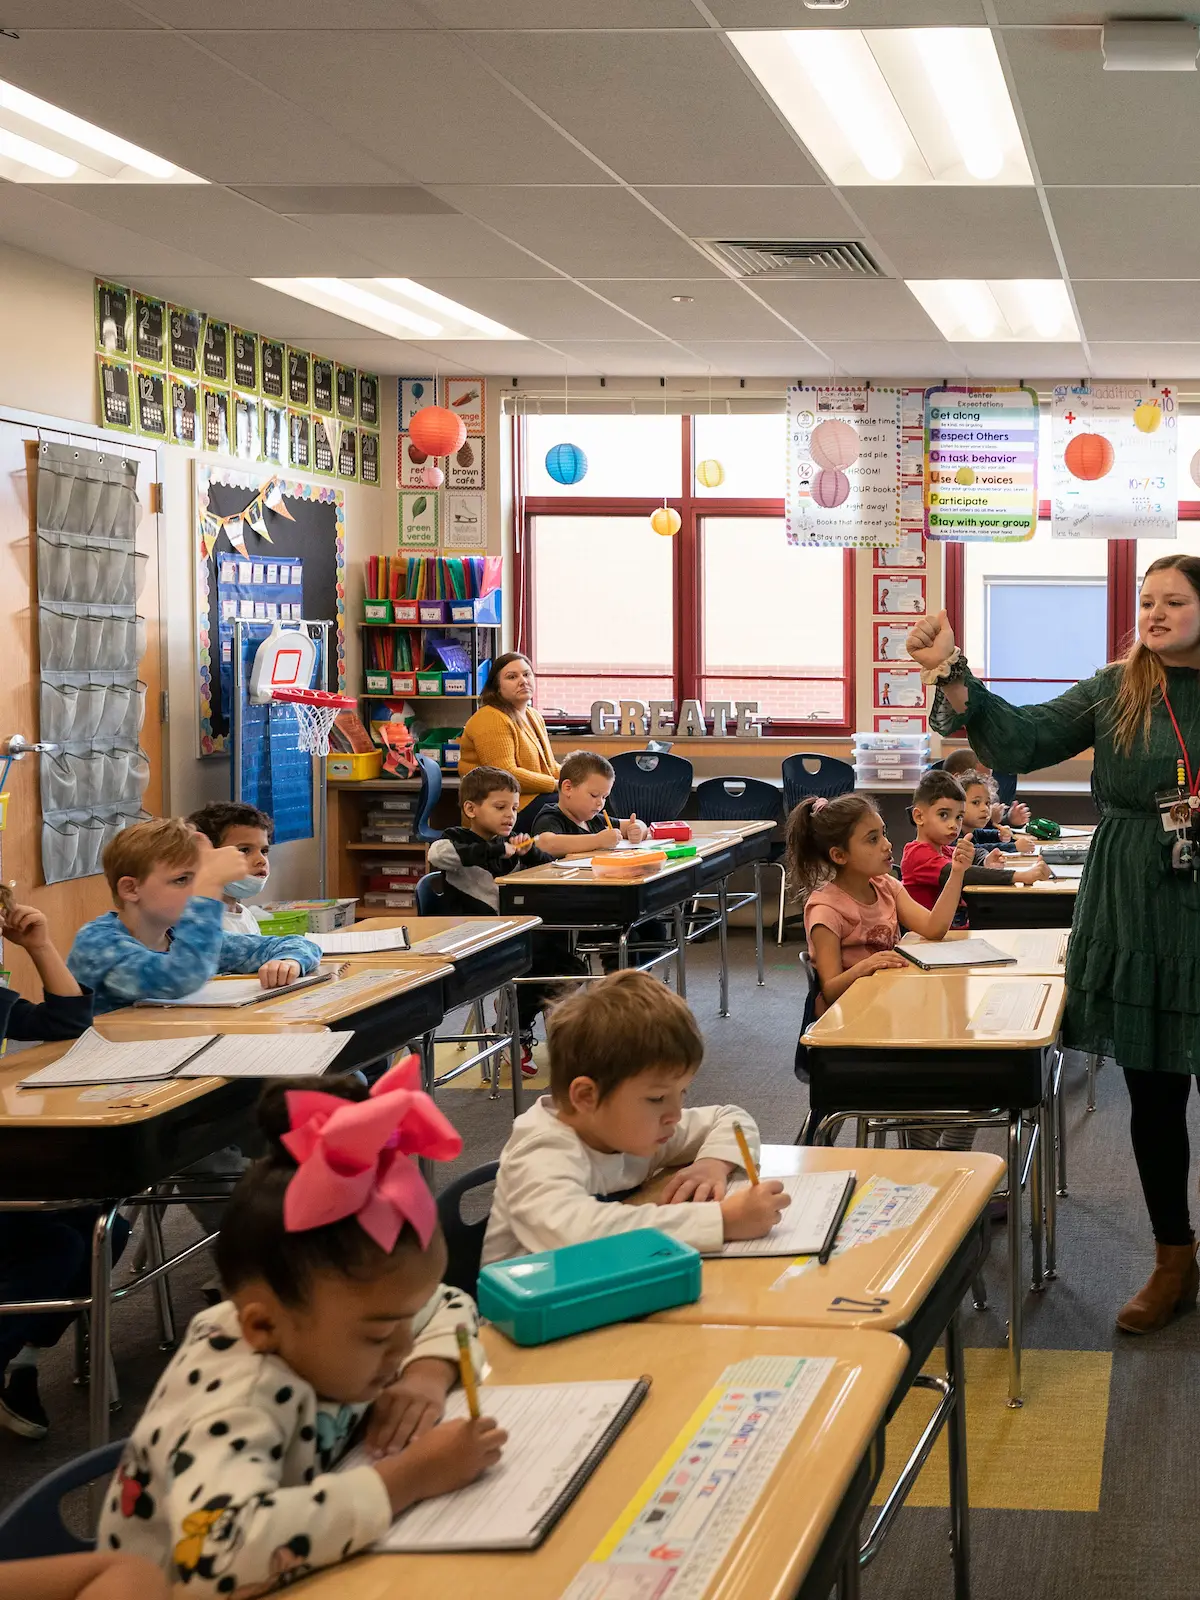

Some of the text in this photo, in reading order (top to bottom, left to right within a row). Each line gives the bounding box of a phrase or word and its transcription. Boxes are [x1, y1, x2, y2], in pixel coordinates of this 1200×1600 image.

[104, 294, 111, 316] 1
[140, 306, 150, 329] 2
[172, 316, 182, 339] 3
[204, 328, 215, 350] 4
[236, 338, 245, 359] 5
[264, 348, 273, 368] 6
[290, 356, 299, 376] 7
[104, 369, 115, 393] 11
[315, 365, 323, 385] 8
[338, 373, 346, 392] 9
[139, 376, 155, 402] 12
[361, 380, 372, 399] 10
[1095, 388, 1142, 399] addition
[172, 386, 186, 410] 13
[957, 400, 1004, 408] Expectations
[1162, 397, 1175, 412] 10
[854, 417, 877, 425] whole
[878, 417, 896, 425] time
[930, 408, 980, 421] Get along
[315, 422, 327, 444] 18
[931, 428, 1009, 442] Respect Others
[362, 434, 375, 456] 20
[930, 450, 1017, 463] On task behavior
[452, 467, 479, 476] brown
[930, 471, 951, 484] Use
[981, 475, 1013, 485] voices
[455, 476, 475, 485] café
[873, 485, 897, 493] books
[866, 503, 888, 511] away!
[930, 493, 988, 507] Participate
[406, 524, 431, 533] green
[839, 518, 852, 526] that
[930, 514, 1030, 529] Stay with your group
[406, 532, 431, 541] verde
[816, 534, 833, 542] Stay
[590, 700, 760, 737] CREATE
[826, 1296, 890, 1314] 21
